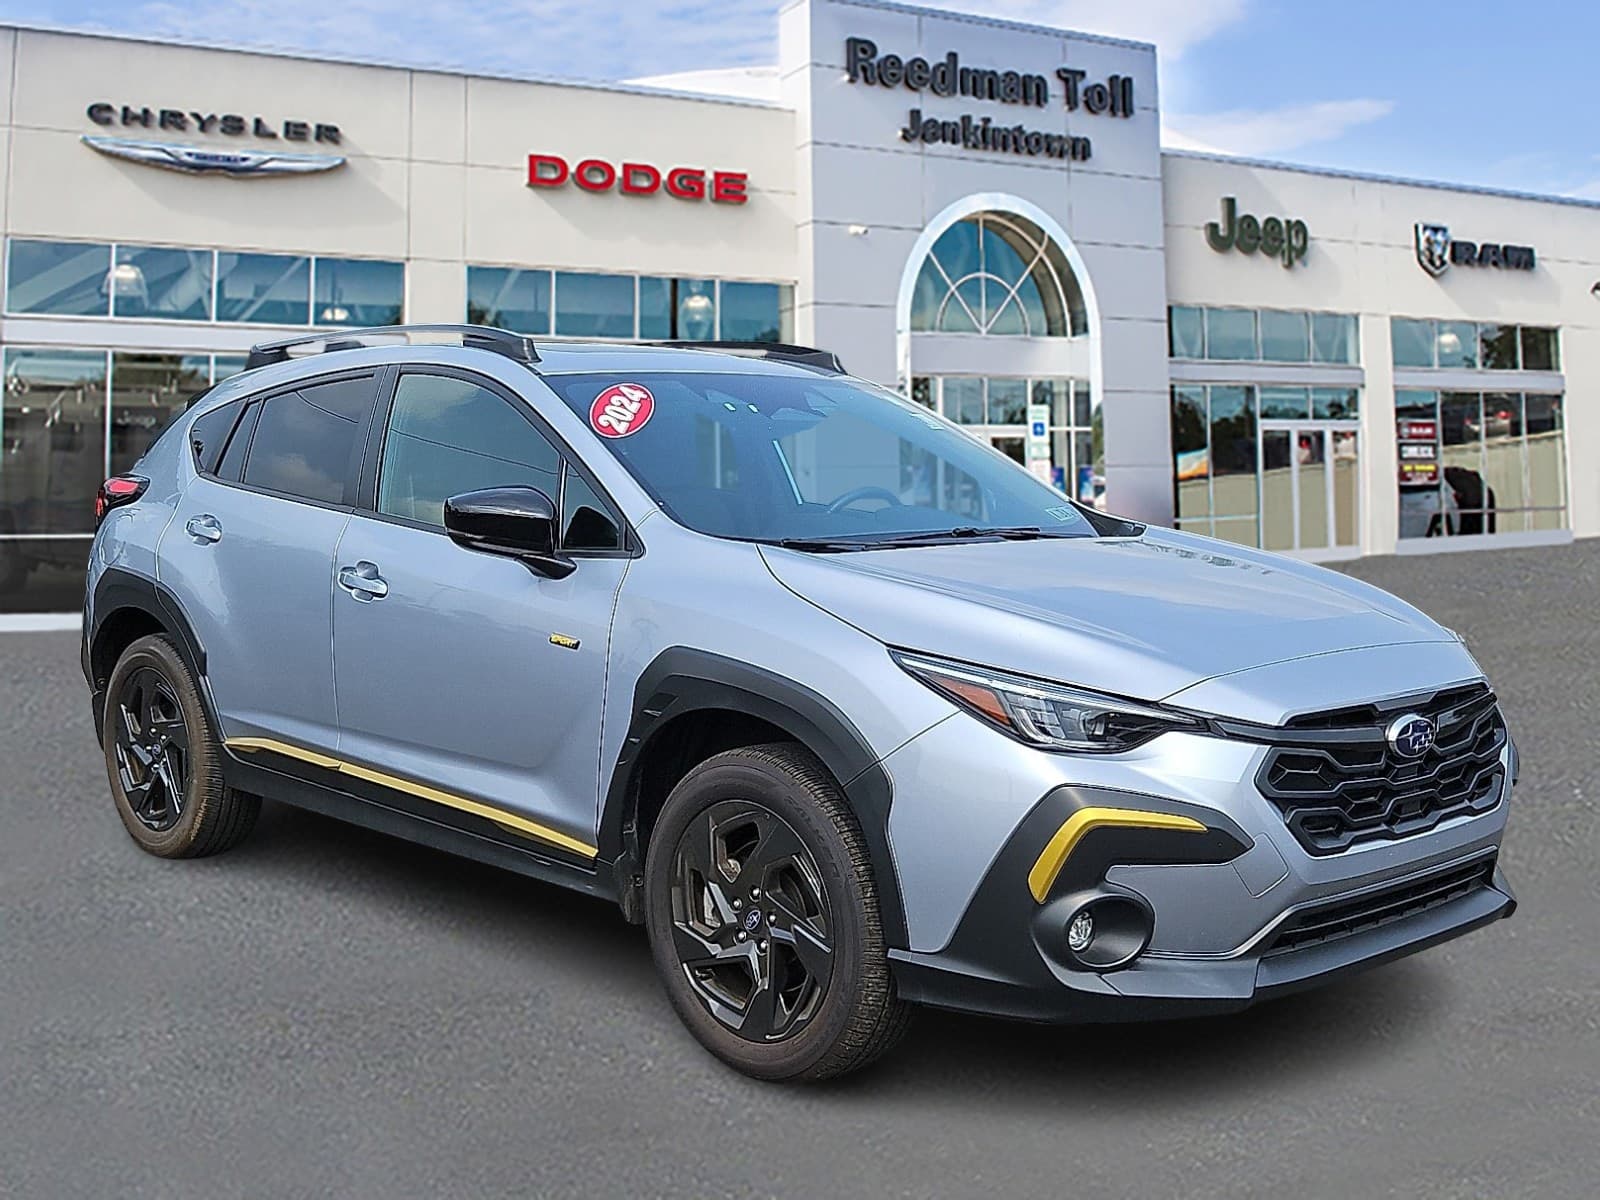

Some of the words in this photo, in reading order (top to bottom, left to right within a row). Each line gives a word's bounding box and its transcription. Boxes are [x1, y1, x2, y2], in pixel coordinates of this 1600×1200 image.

[845, 37, 1050, 107] Reedman
[1056, 67, 1135, 119] Toll
[86, 102, 341, 144] CHRYSLER
[900, 109, 1093, 162] Jenkintown
[527, 154, 749, 205] DODGE
[1204, 196, 1309, 270] Jeep
[1449, 240, 1536, 272] RAM
[597, 385, 648, 434] 2024
